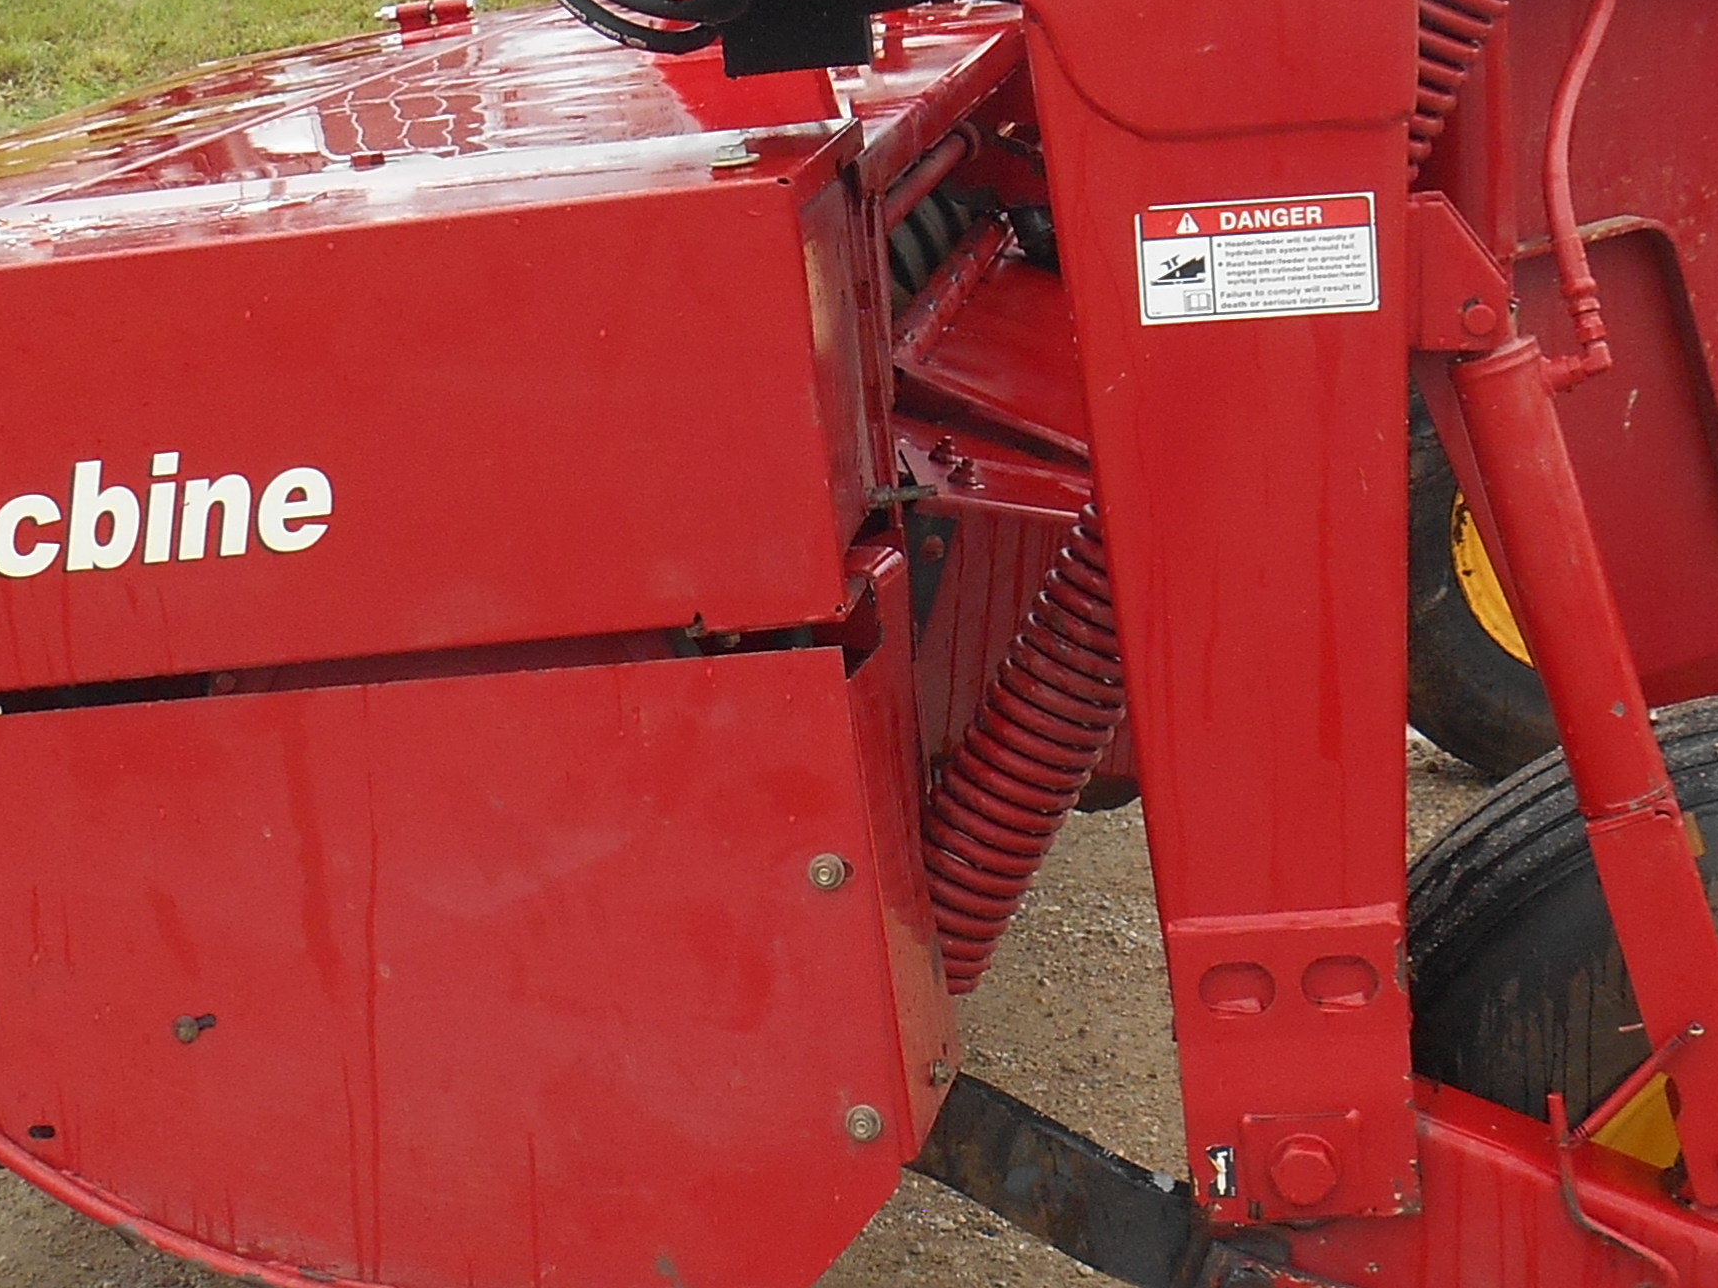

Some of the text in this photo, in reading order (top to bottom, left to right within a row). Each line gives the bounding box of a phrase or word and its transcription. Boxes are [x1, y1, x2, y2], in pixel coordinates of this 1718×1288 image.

[1219, 205, 1323, 231] DANGER
[1318, 233, 1347, 242] rapidly
[1225, 248, 1263, 257] hydraulic
[1279, 246, 1308, 255] system
[1311, 243, 1339, 251] should
[1321, 253, 1350, 263] ground
[1226, 269, 1256, 277] engage
[1272, 265, 1304, 274] cylinder
[1227, 277, 1257, 285] working
[1259, 275, 1286, 283] around
[1220, 290, 1252, 299] Failure
[1268, 287, 1301, 295] comply
[1304, 285, 1320, 293] will
[1323, 283, 1350, 291] result
[1220, 300, 1248, 309] death
[1263, 297, 1297, 306] serious
